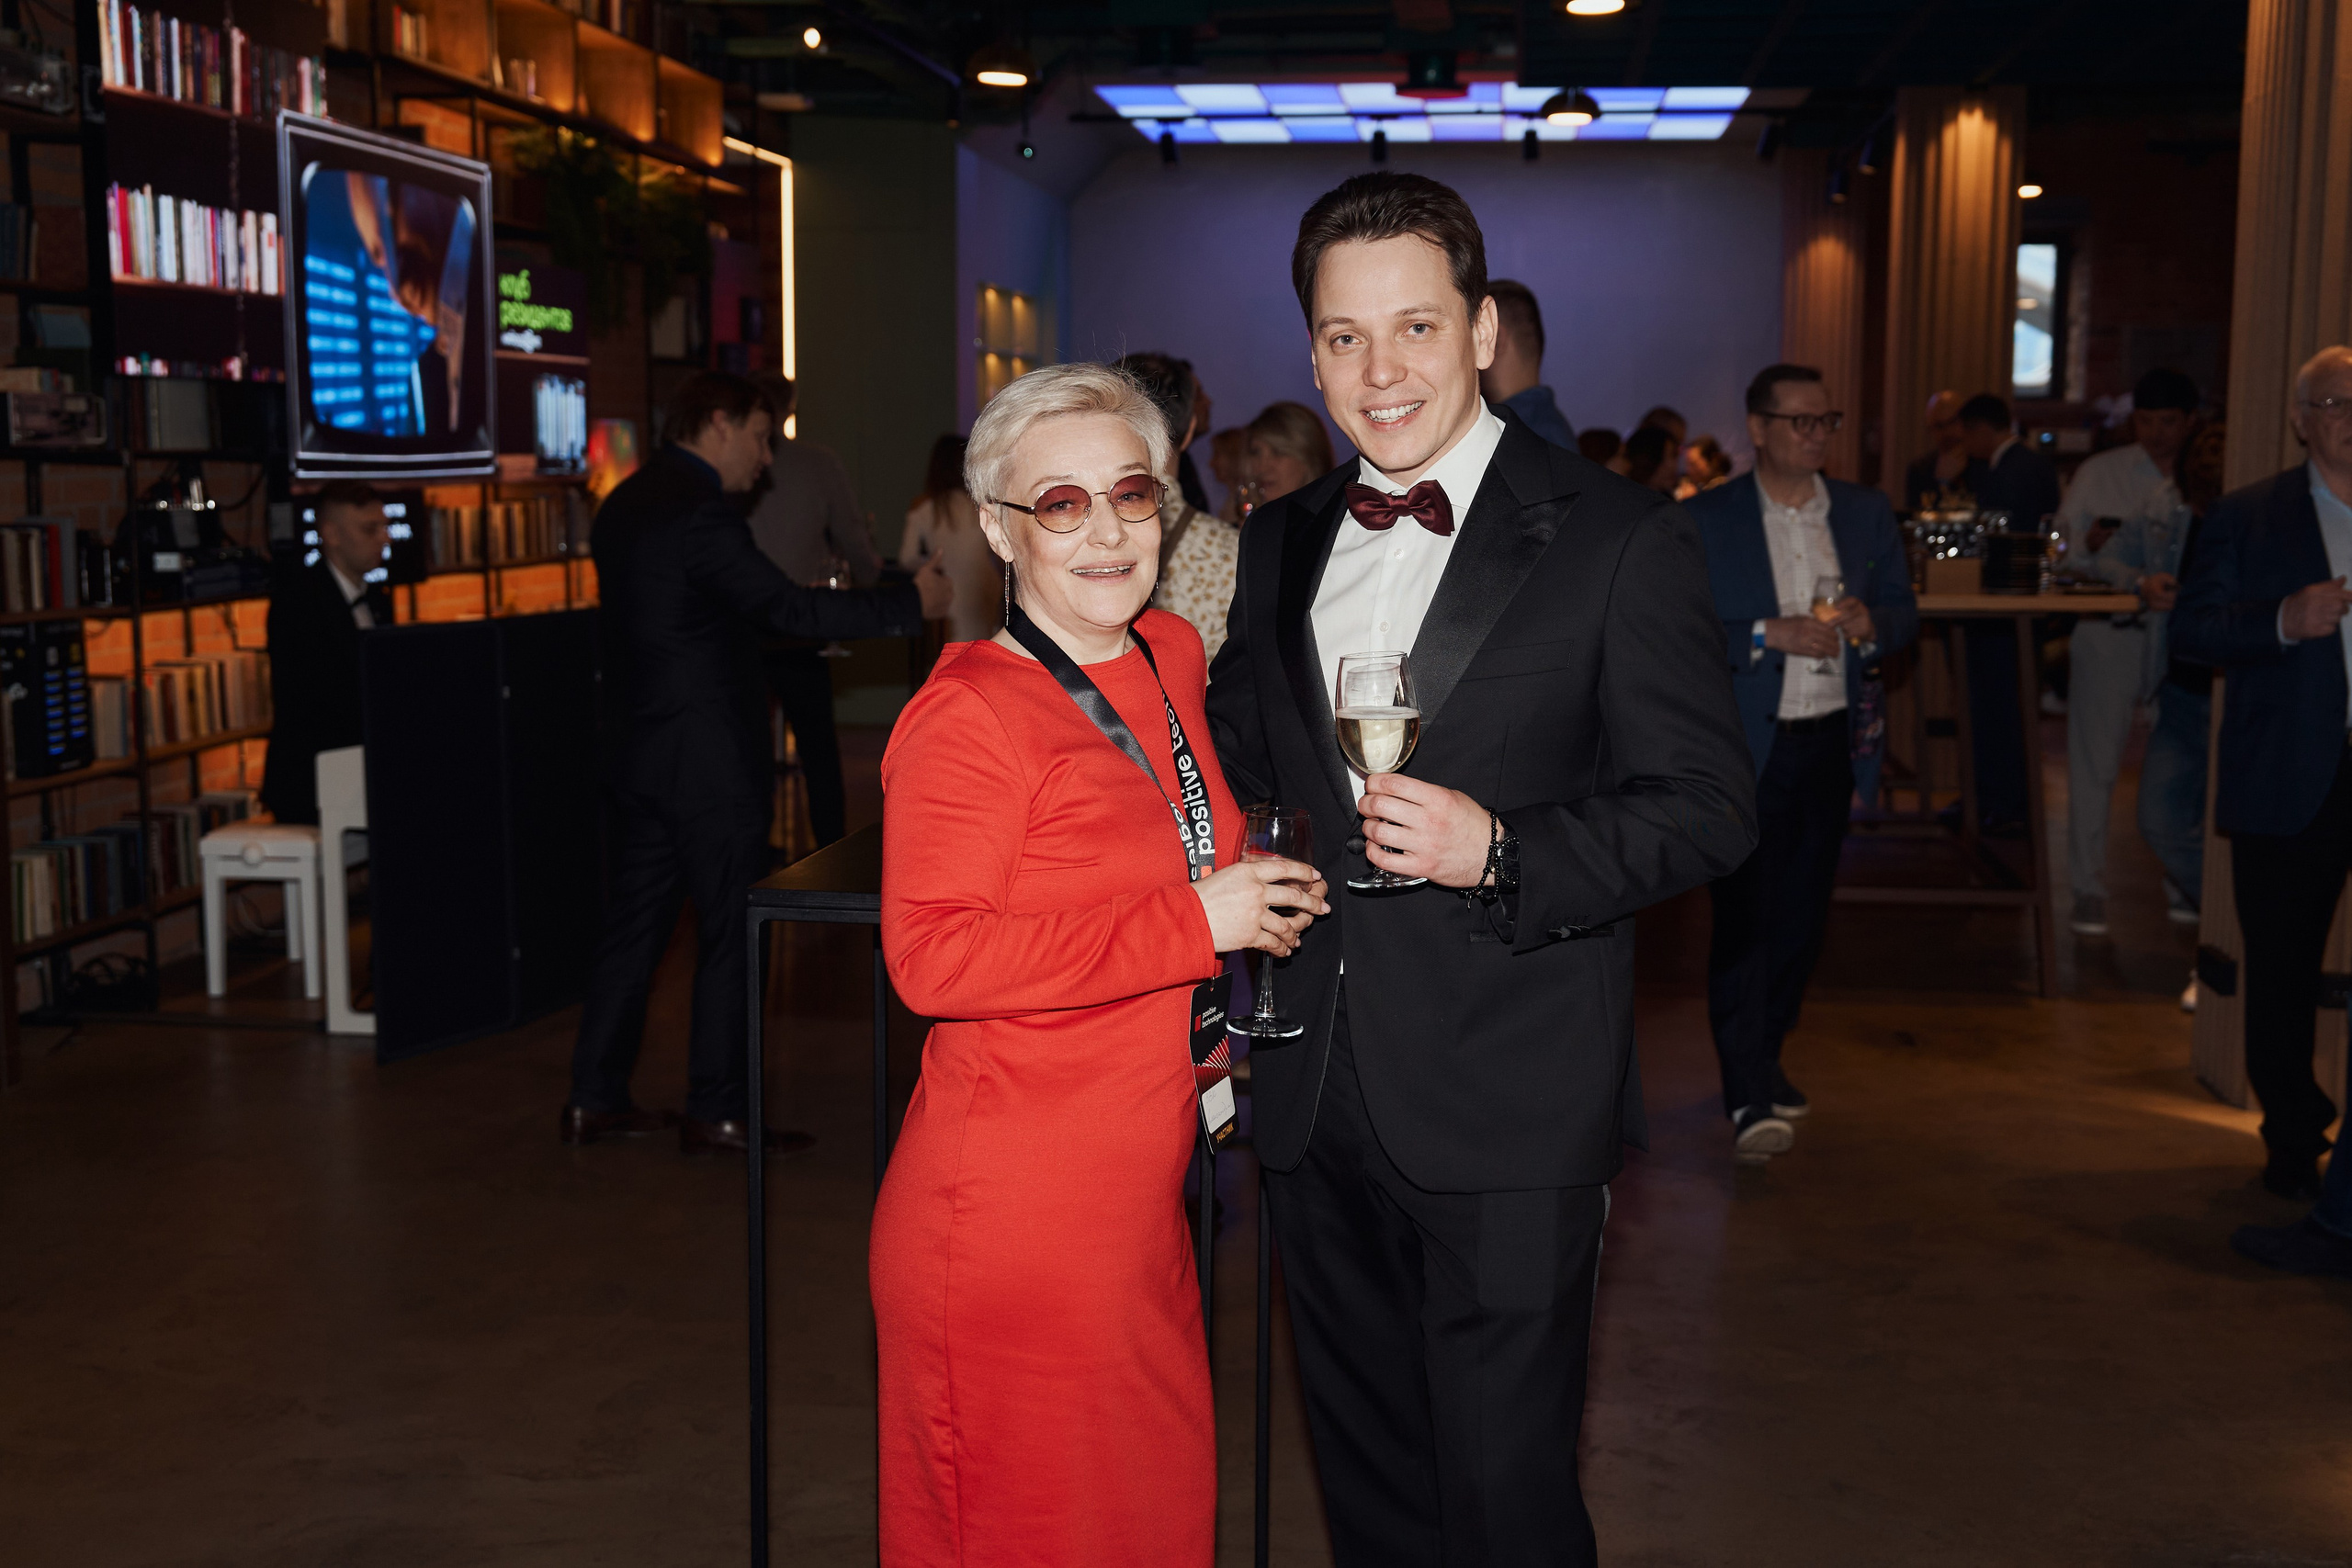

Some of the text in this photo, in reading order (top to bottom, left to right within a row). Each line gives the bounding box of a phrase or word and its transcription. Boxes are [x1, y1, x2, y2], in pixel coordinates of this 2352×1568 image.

[1178, 753, 1216, 855] positive
[1202, 1011, 1225, 1029] technologies
[1203, 1006, 1216, 1021] positive
